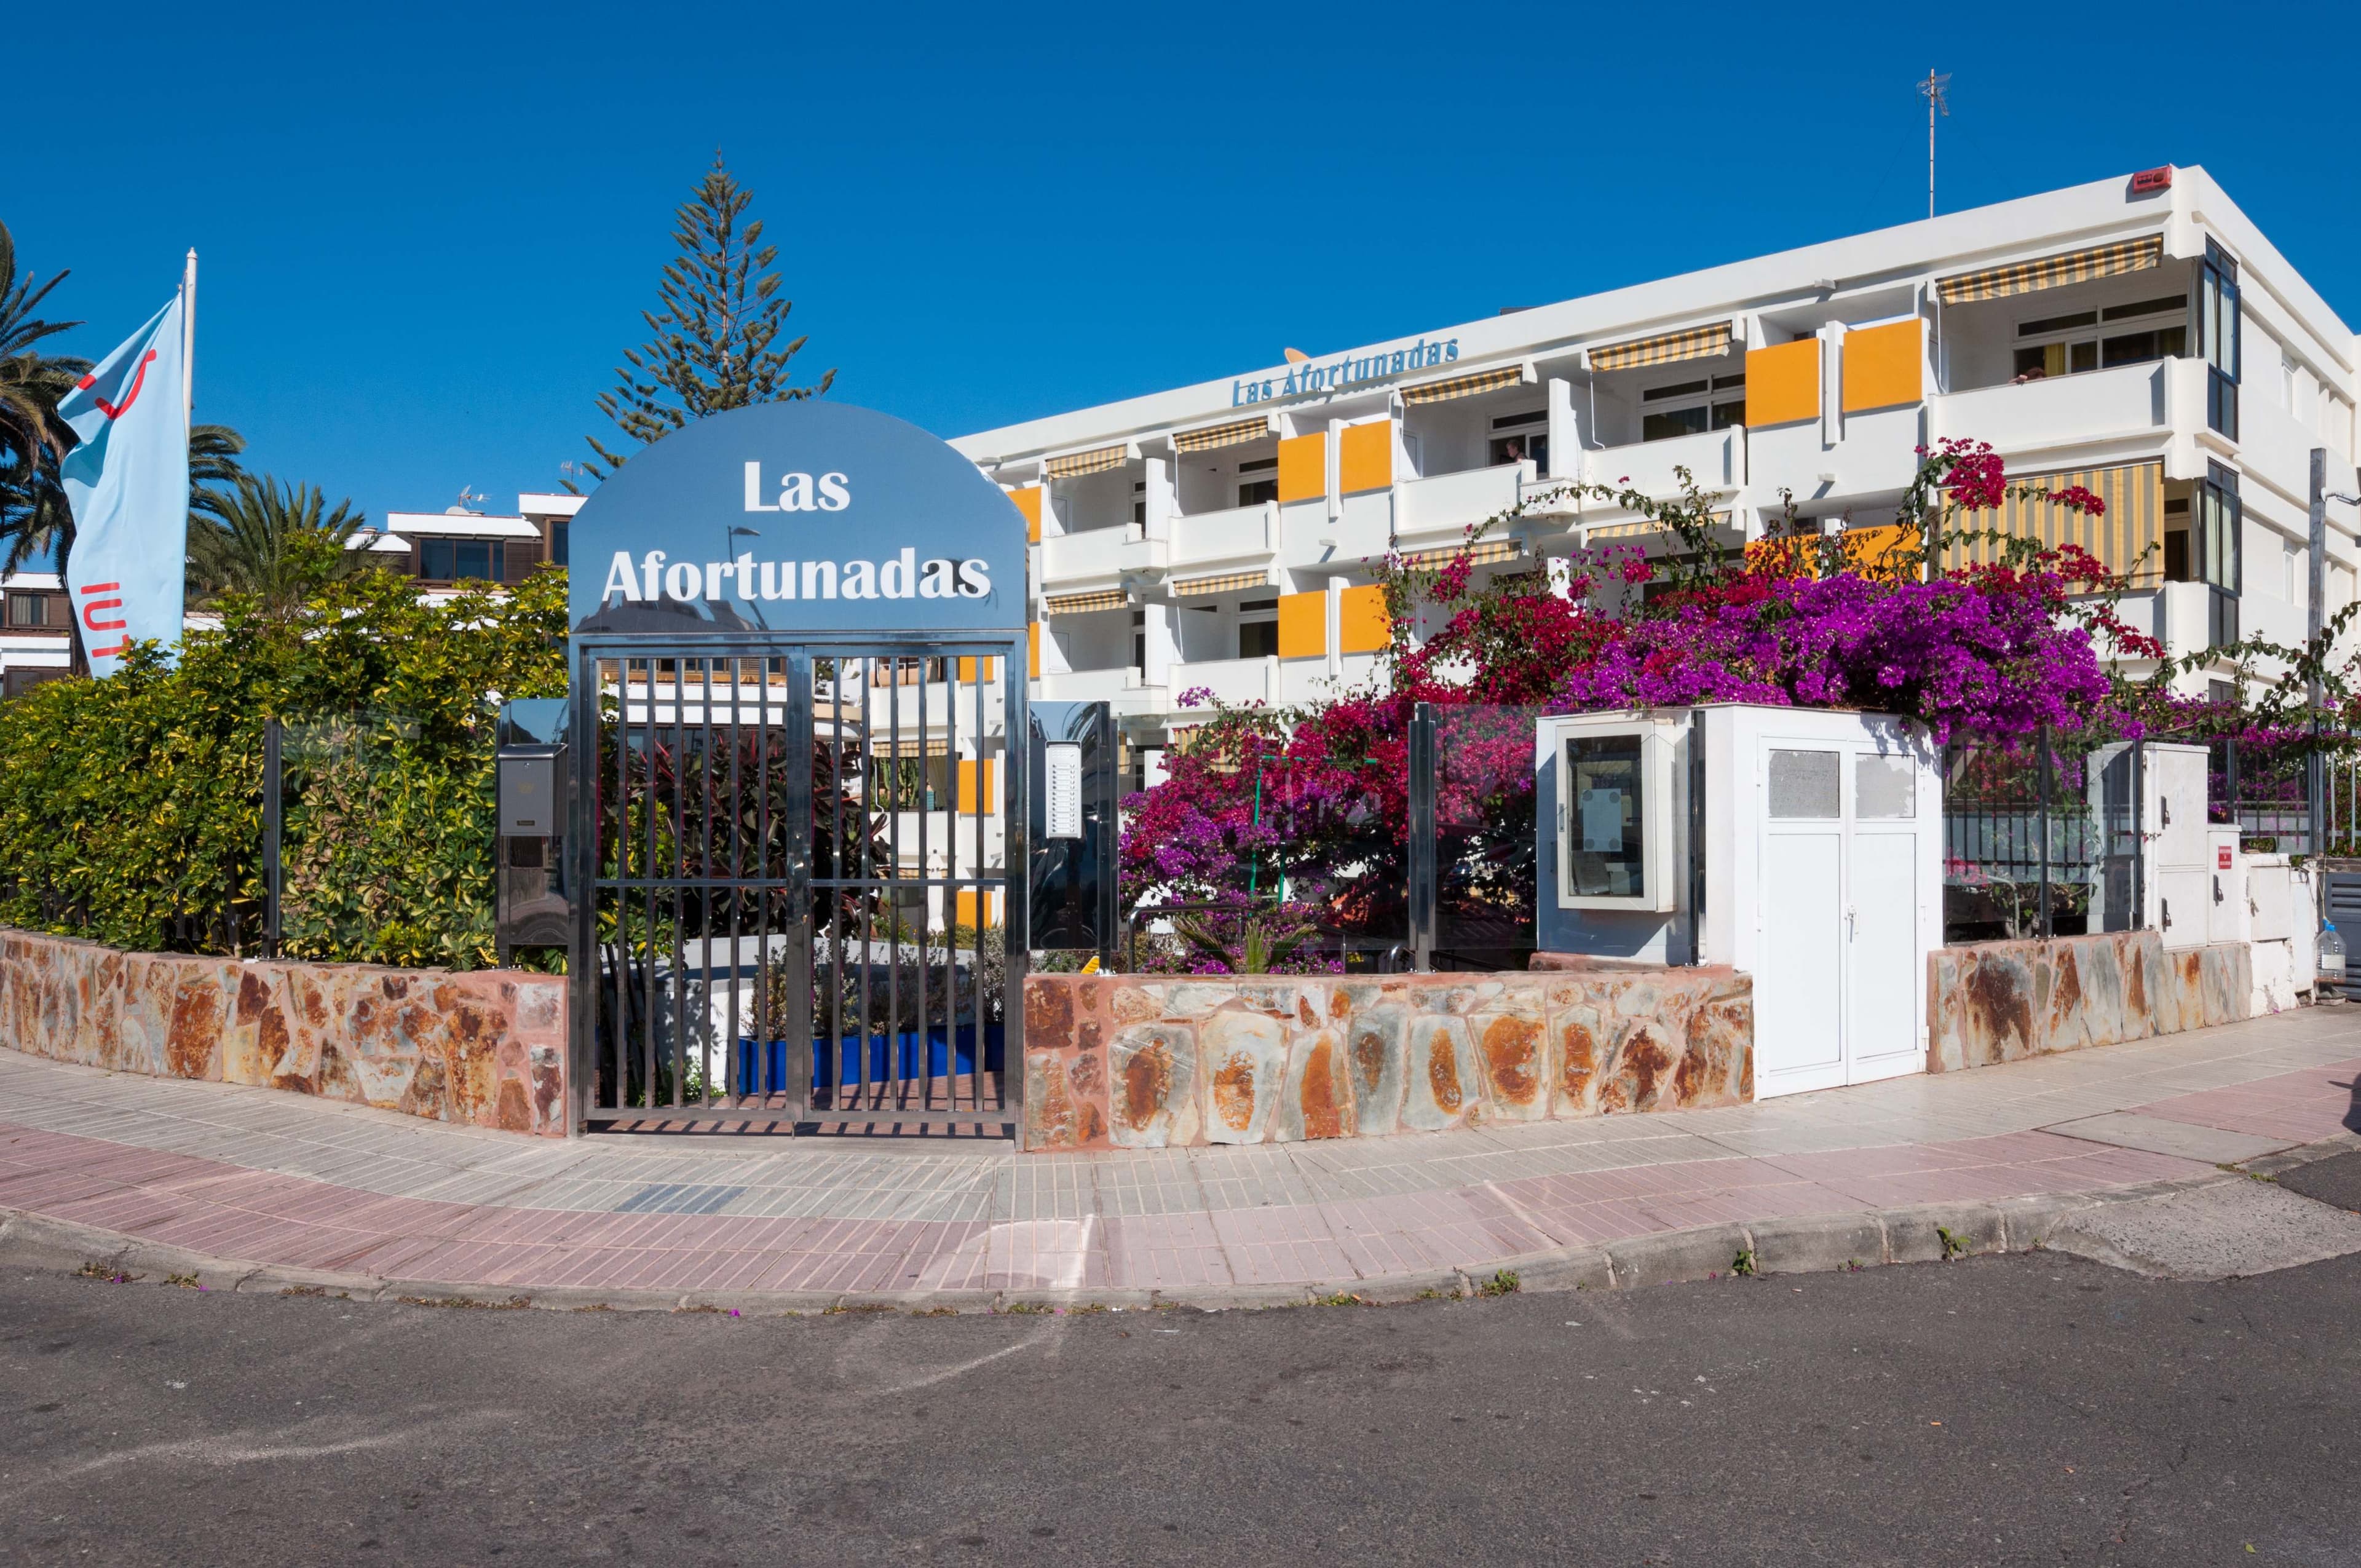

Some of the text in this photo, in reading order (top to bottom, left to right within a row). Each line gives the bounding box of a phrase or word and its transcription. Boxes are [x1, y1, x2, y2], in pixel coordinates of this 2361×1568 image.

[1232, 338, 1458, 408] Las Afortunadas
[745, 462, 850, 511] Las
[602, 547, 991, 601] Afortunadas
